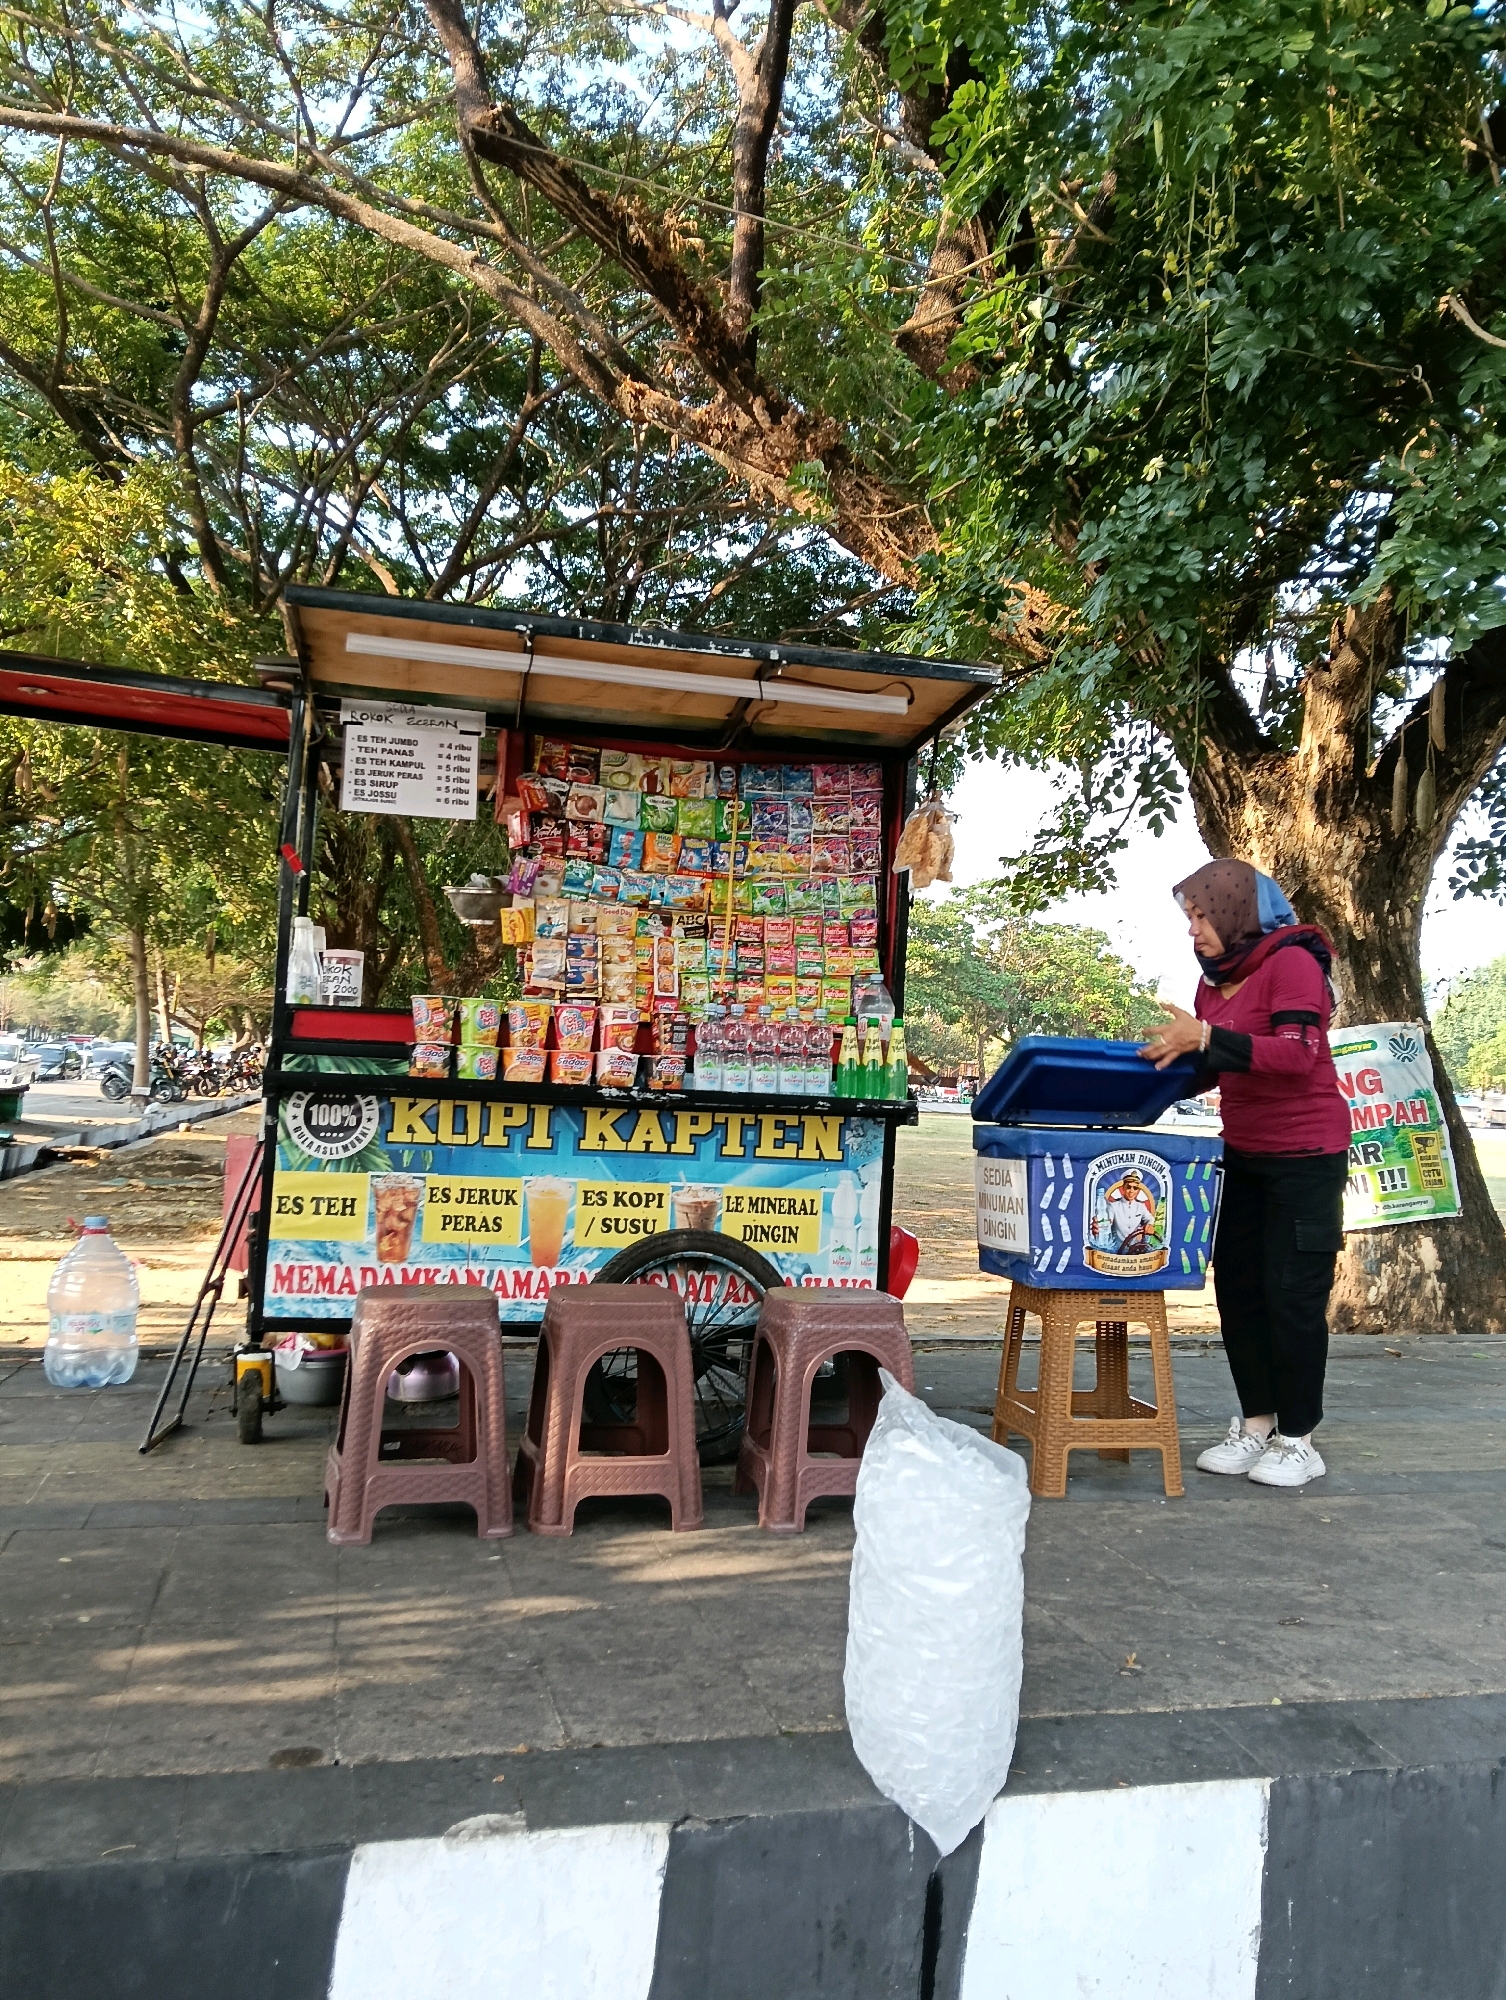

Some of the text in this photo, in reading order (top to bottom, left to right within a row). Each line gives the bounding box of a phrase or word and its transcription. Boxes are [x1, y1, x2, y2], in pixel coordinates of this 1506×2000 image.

[350, 710, 394, 724] ROKOK
[371, 736, 387, 744] TEH
[389, 738, 419, 747] JUMBO
[356, 757, 366, 765] ES
[370, 758, 386, 767] TEH
[390, 760, 426, 770] KAMPUL
[357, 746, 378, 754] TEH
[381, 748, 414, 757] PANAS
[453, 754, 471, 762] ribu
[355, 768, 365, 776] ES
[367, 770, 395, 778] JERUK
[397, 771, 423, 781] PERAS
[369, 780, 399, 789] SIRUP
[444, 786, 450, 794] 5
[452, 787, 469, 795] ribu
[368, 790, 397, 799] JOSSU
[452, 798, 469, 806] ribu
[603, 907, 633, 917] Good Day
[676, 915, 705, 926] ABC
[333, 985, 358, 995] 2000
[1336, 1068, 1384, 1099] NG
[309, 1104, 357, 1127] 100%
[1351, 1100, 1429, 1131] MPAH
[386, 1097, 846, 1161] KOPI KAPTEN
[314, 1144, 340, 1156] ASLI
[341, 1126, 371, 1153] MURNI
[1348, 1142, 1383, 1168] AR
[983, 1167, 1013, 1188] SEDIA
[1423, 1169, 1441, 1177] CCTV
[1343, 1174, 1369, 1197] NI
[275, 1196, 357, 1217] ES TEH
[429, 1187, 519, 1207] ES JERUK
[582, 1189, 665, 1209] ES KOPI
[725, 1195, 819, 1217] LE MINERAL
[441, 1214, 503, 1233] PERAS
[600, 1217, 657, 1235] SUSU
[742, 1225, 800, 1244] DINGIN
[272, 1264, 485, 1295] MEMADAMKAN
[493, 1269, 602, 1299] AMARA
